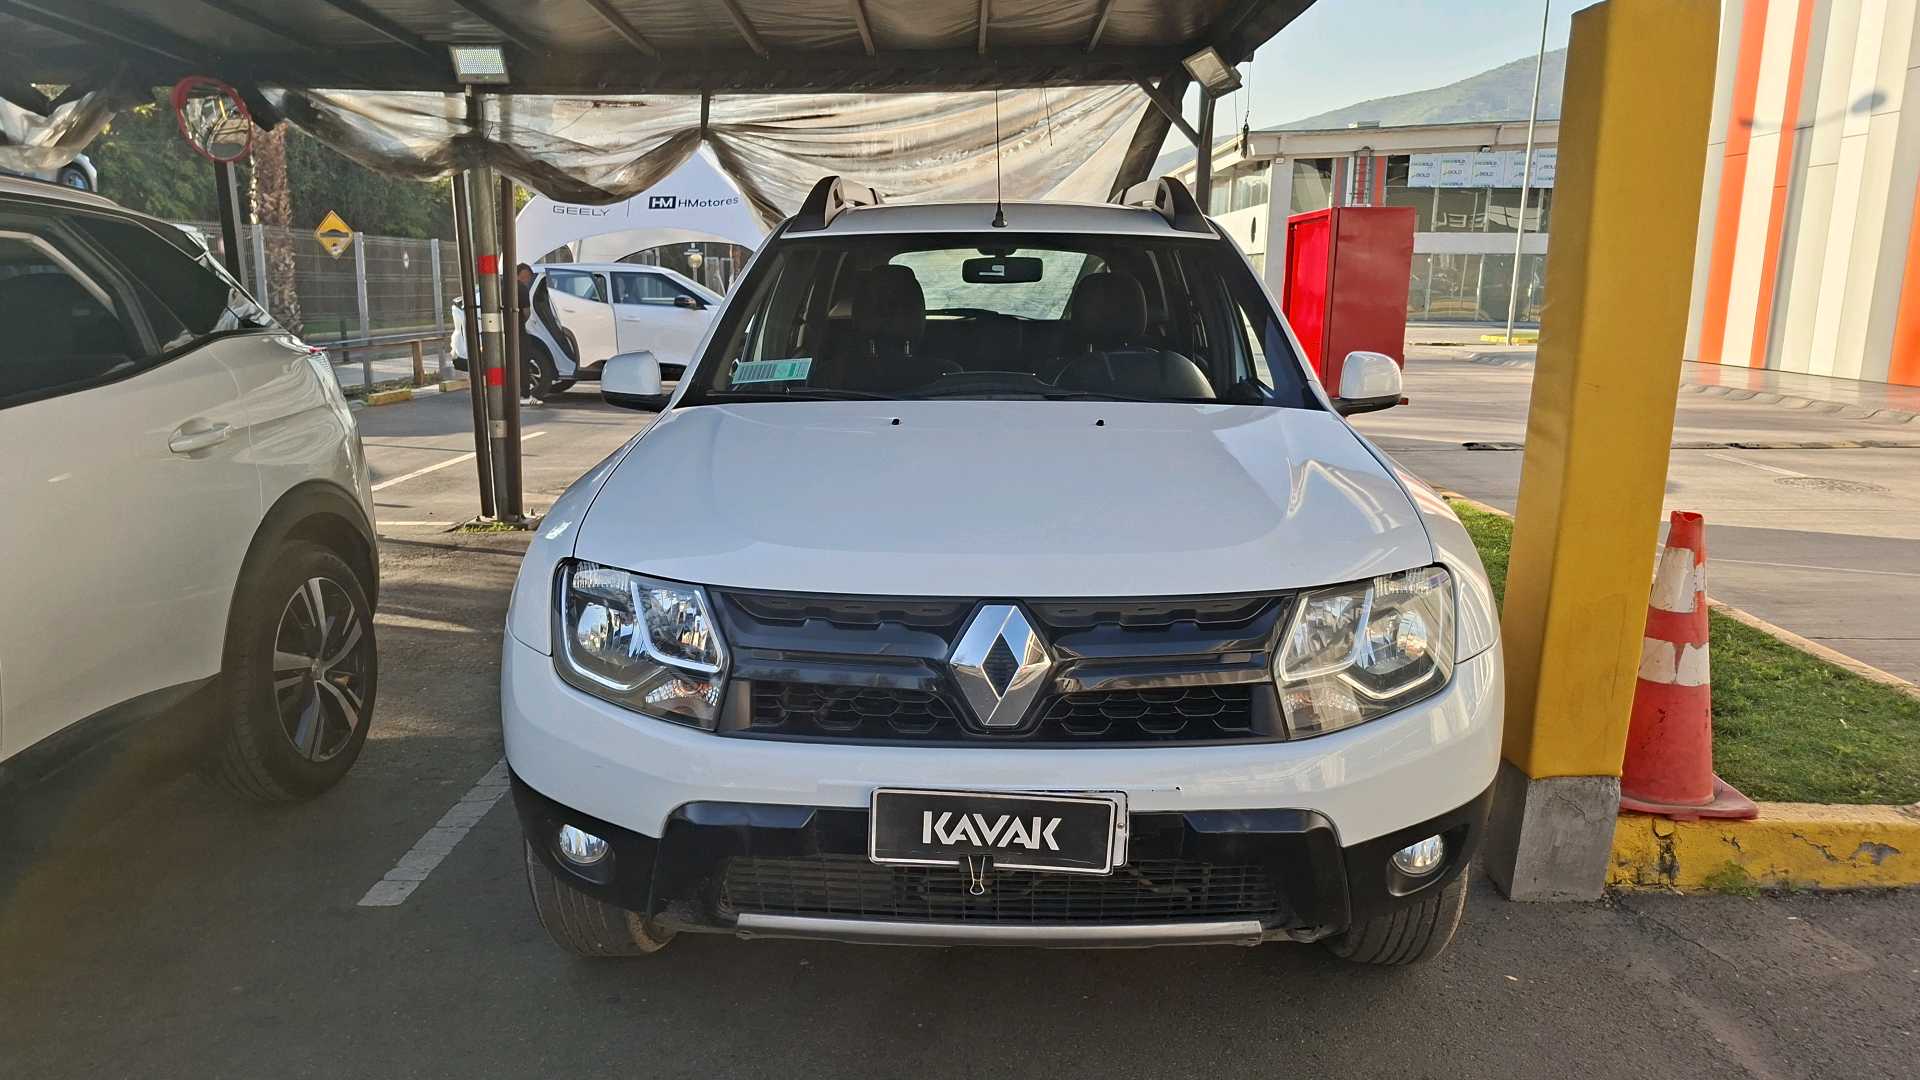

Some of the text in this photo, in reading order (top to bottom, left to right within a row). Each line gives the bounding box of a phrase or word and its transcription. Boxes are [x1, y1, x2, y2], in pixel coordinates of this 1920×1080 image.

[650, 196, 739, 208] HM HMotores
[552, 204, 610, 217] GEELY
[922, 810, 1062, 851] KAVAK
